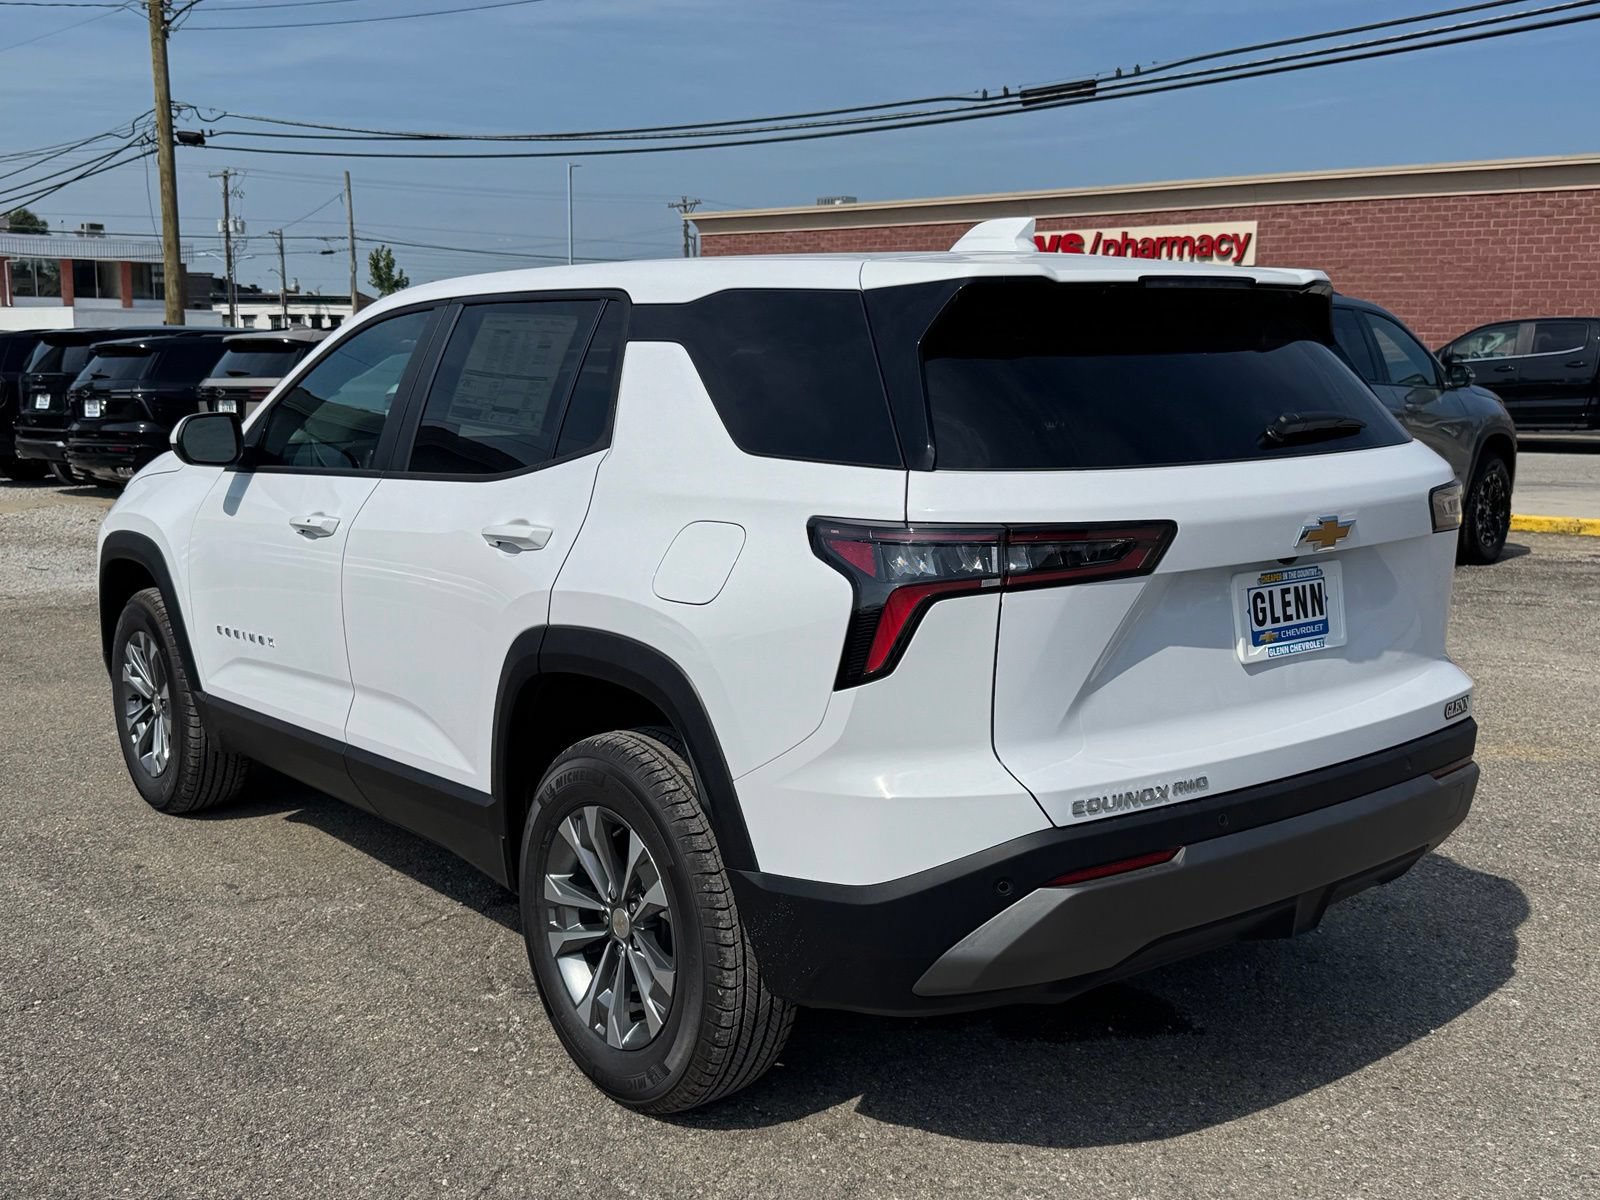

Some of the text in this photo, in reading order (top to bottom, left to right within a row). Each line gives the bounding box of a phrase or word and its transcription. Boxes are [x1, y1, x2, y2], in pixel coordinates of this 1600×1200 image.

[1282, 571, 1288, 580] IN
[1288, 570, 1297, 579] THE
[1252, 583, 1324, 627] GLENN
[216, 625, 275, 648] EQUINOX
[1281, 624, 1323, 637] CHEVROLET
[1268, 640, 1323, 656] GLENN CHEVROLET
[1072, 783, 1170, 818] EQUINOX
